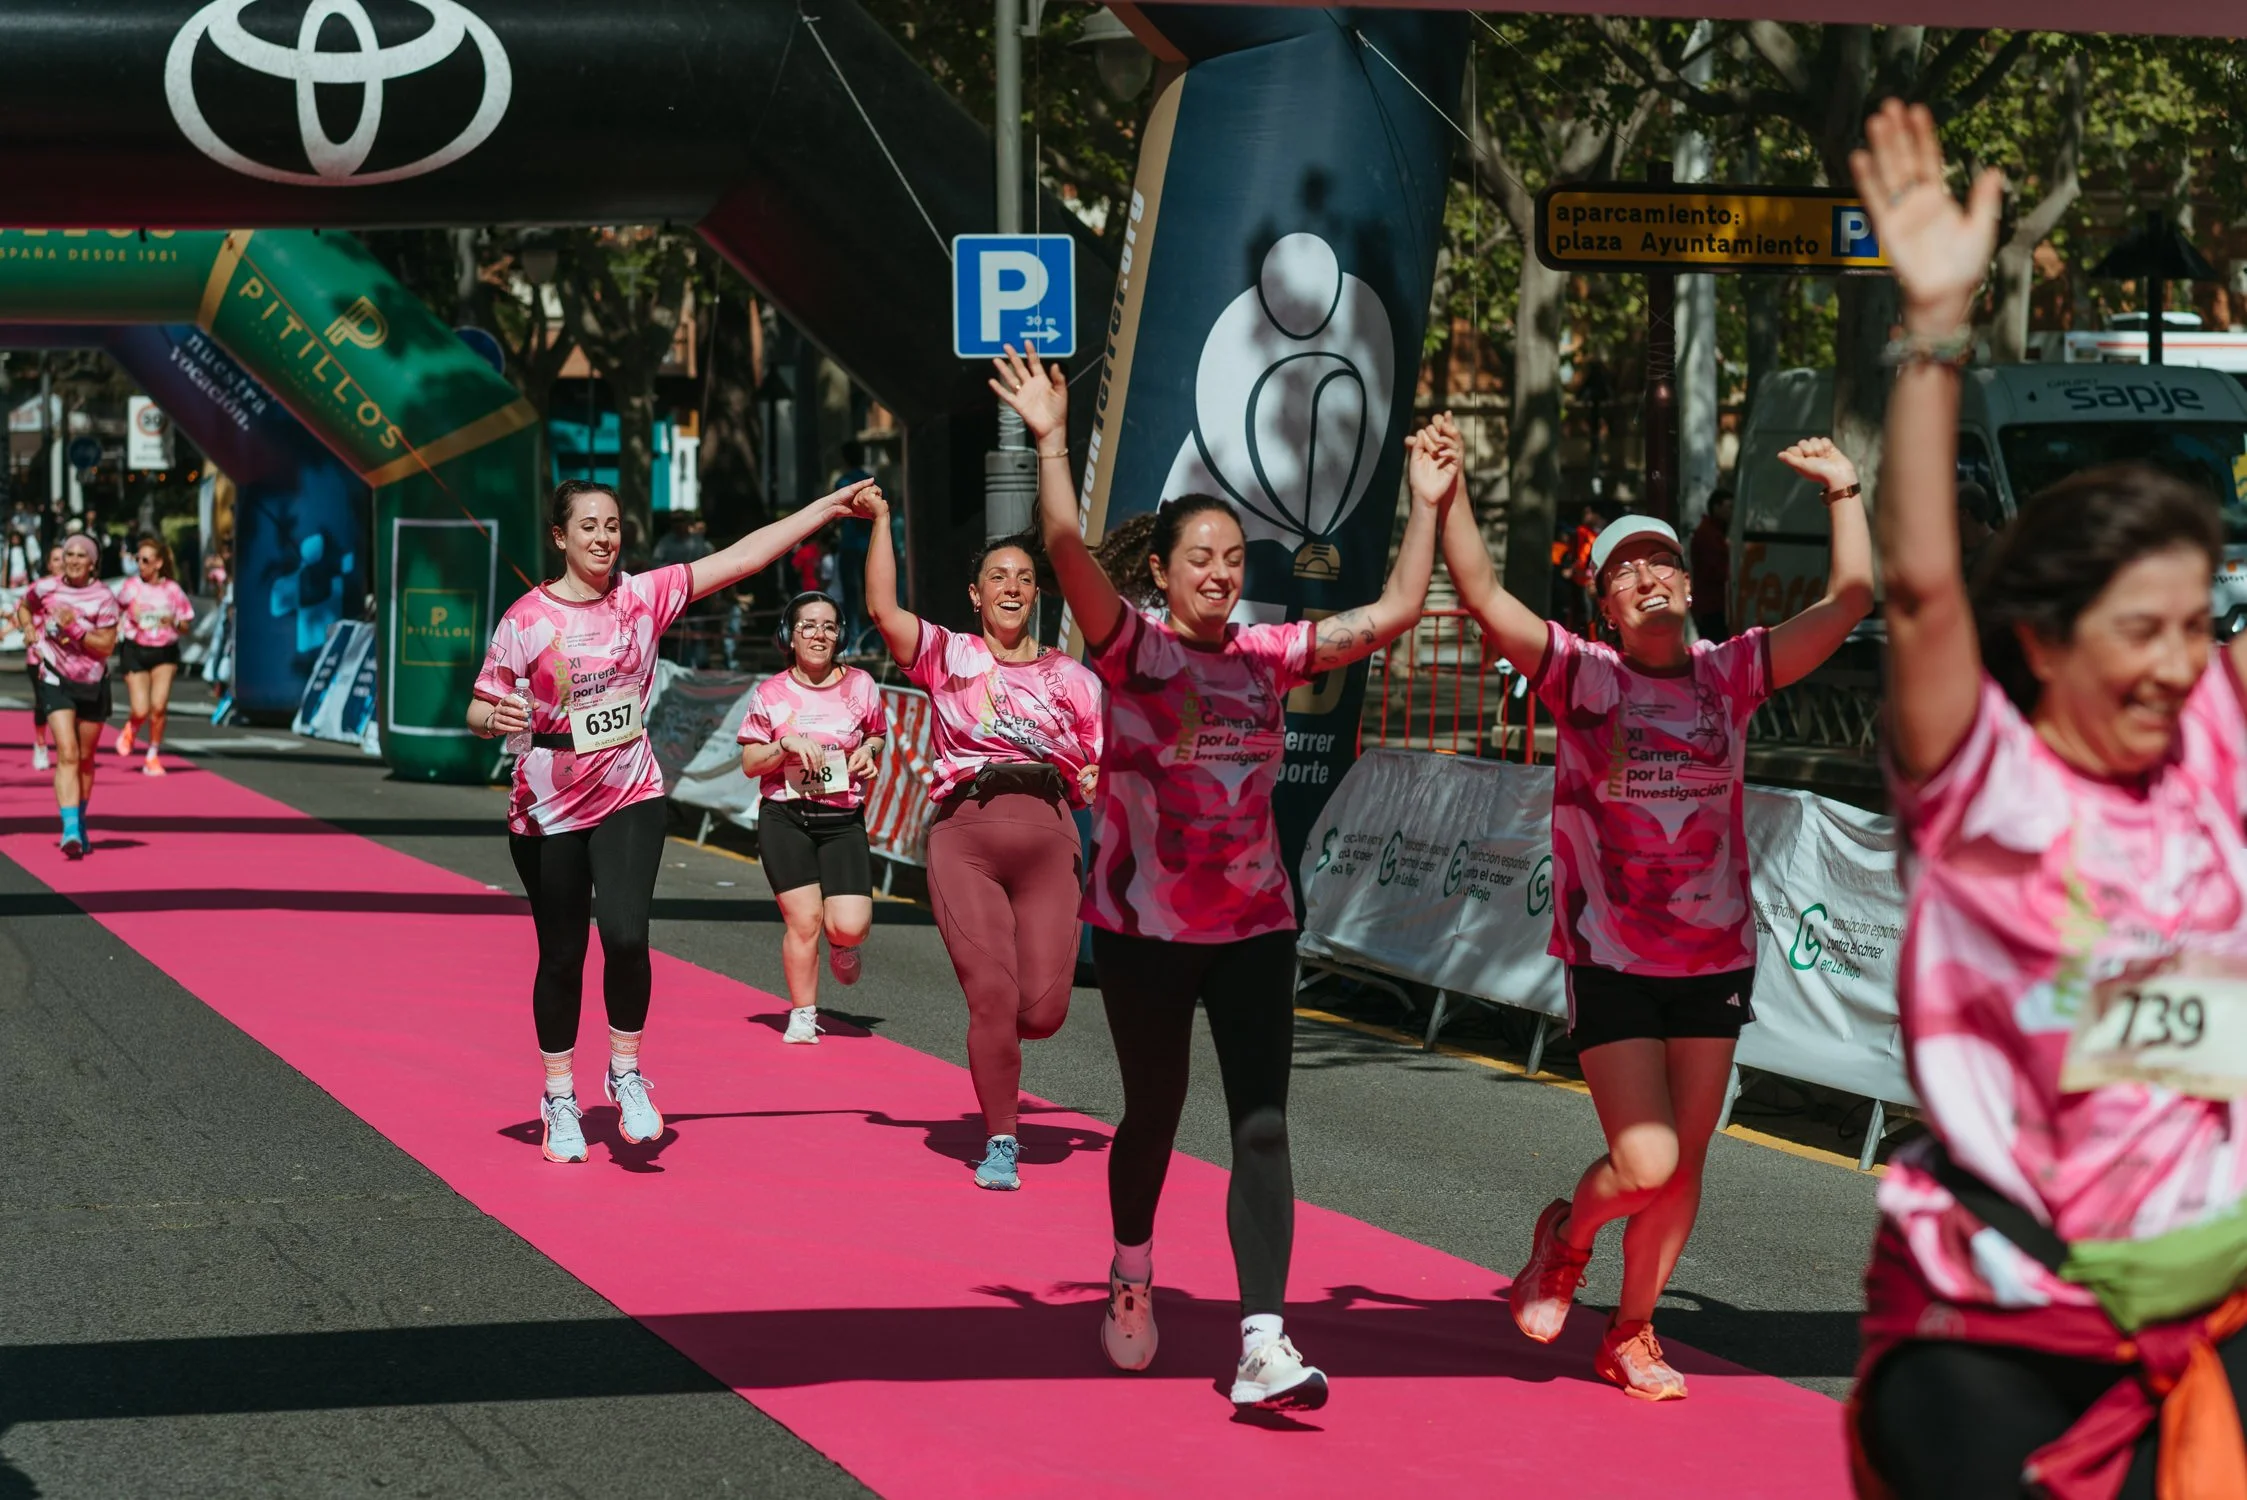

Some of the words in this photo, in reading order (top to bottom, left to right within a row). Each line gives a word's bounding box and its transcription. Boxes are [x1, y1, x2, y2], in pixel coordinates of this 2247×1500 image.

[1556, 203, 1741, 226] aparcamiento:
[1840, 211, 1871, 253] P
[1556, 231, 1622, 255] plaza
[1641, 231, 1819, 256] Ayuntamiento
[68, 249, 126, 261] DESDE
[979, 250, 1049, 342] P
[1026, 315, 1042, 326] 30
[1045, 317, 1056, 326] m
[239, 277, 400, 449] PITILLOS
[187, 334, 267, 416] nuestra
[169, 346, 250, 431] vocación.
[2064, 381, 2205, 414] sapje
[568, 656, 581, 670] XI
[571, 666, 616, 685] Carrera
[573, 688, 595, 701] por
[595, 684, 606, 694] la
[585, 704, 631, 735] 6357
[1201, 710, 1255, 729] Carrera
[1197, 733, 1223, 749] por
[1225, 732, 1240, 746] la
[1283, 725, 1336, 753] errer
[1627, 727, 1643, 742] XI
[1628, 746, 1690, 763] Carrera
[800, 766, 833, 785] 248
[1275, 760, 1329, 785] porte
[1627, 767, 1655, 784] por
[1658, 766, 1673, 781] la
[1626, 783, 1728, 800] Investigación
[1480, 869, 1488, 881] el
[1489, 871, 1514, 886] cáncer
[1469, 884, 1490, 903] Rioja
[1832, 916, 1869, 935] asociación
[1870, 924, 1905, 941] española
[1827, 937, 1848, 953] contra
[1858, 942, 1884, 959] cáncer
[1820, 958, 1831, 972] en
[1831, 959, 1842, 973] La
[1843, 961, 1861, 982] Rioja
[2119, 988, 2206, 1048] 739
